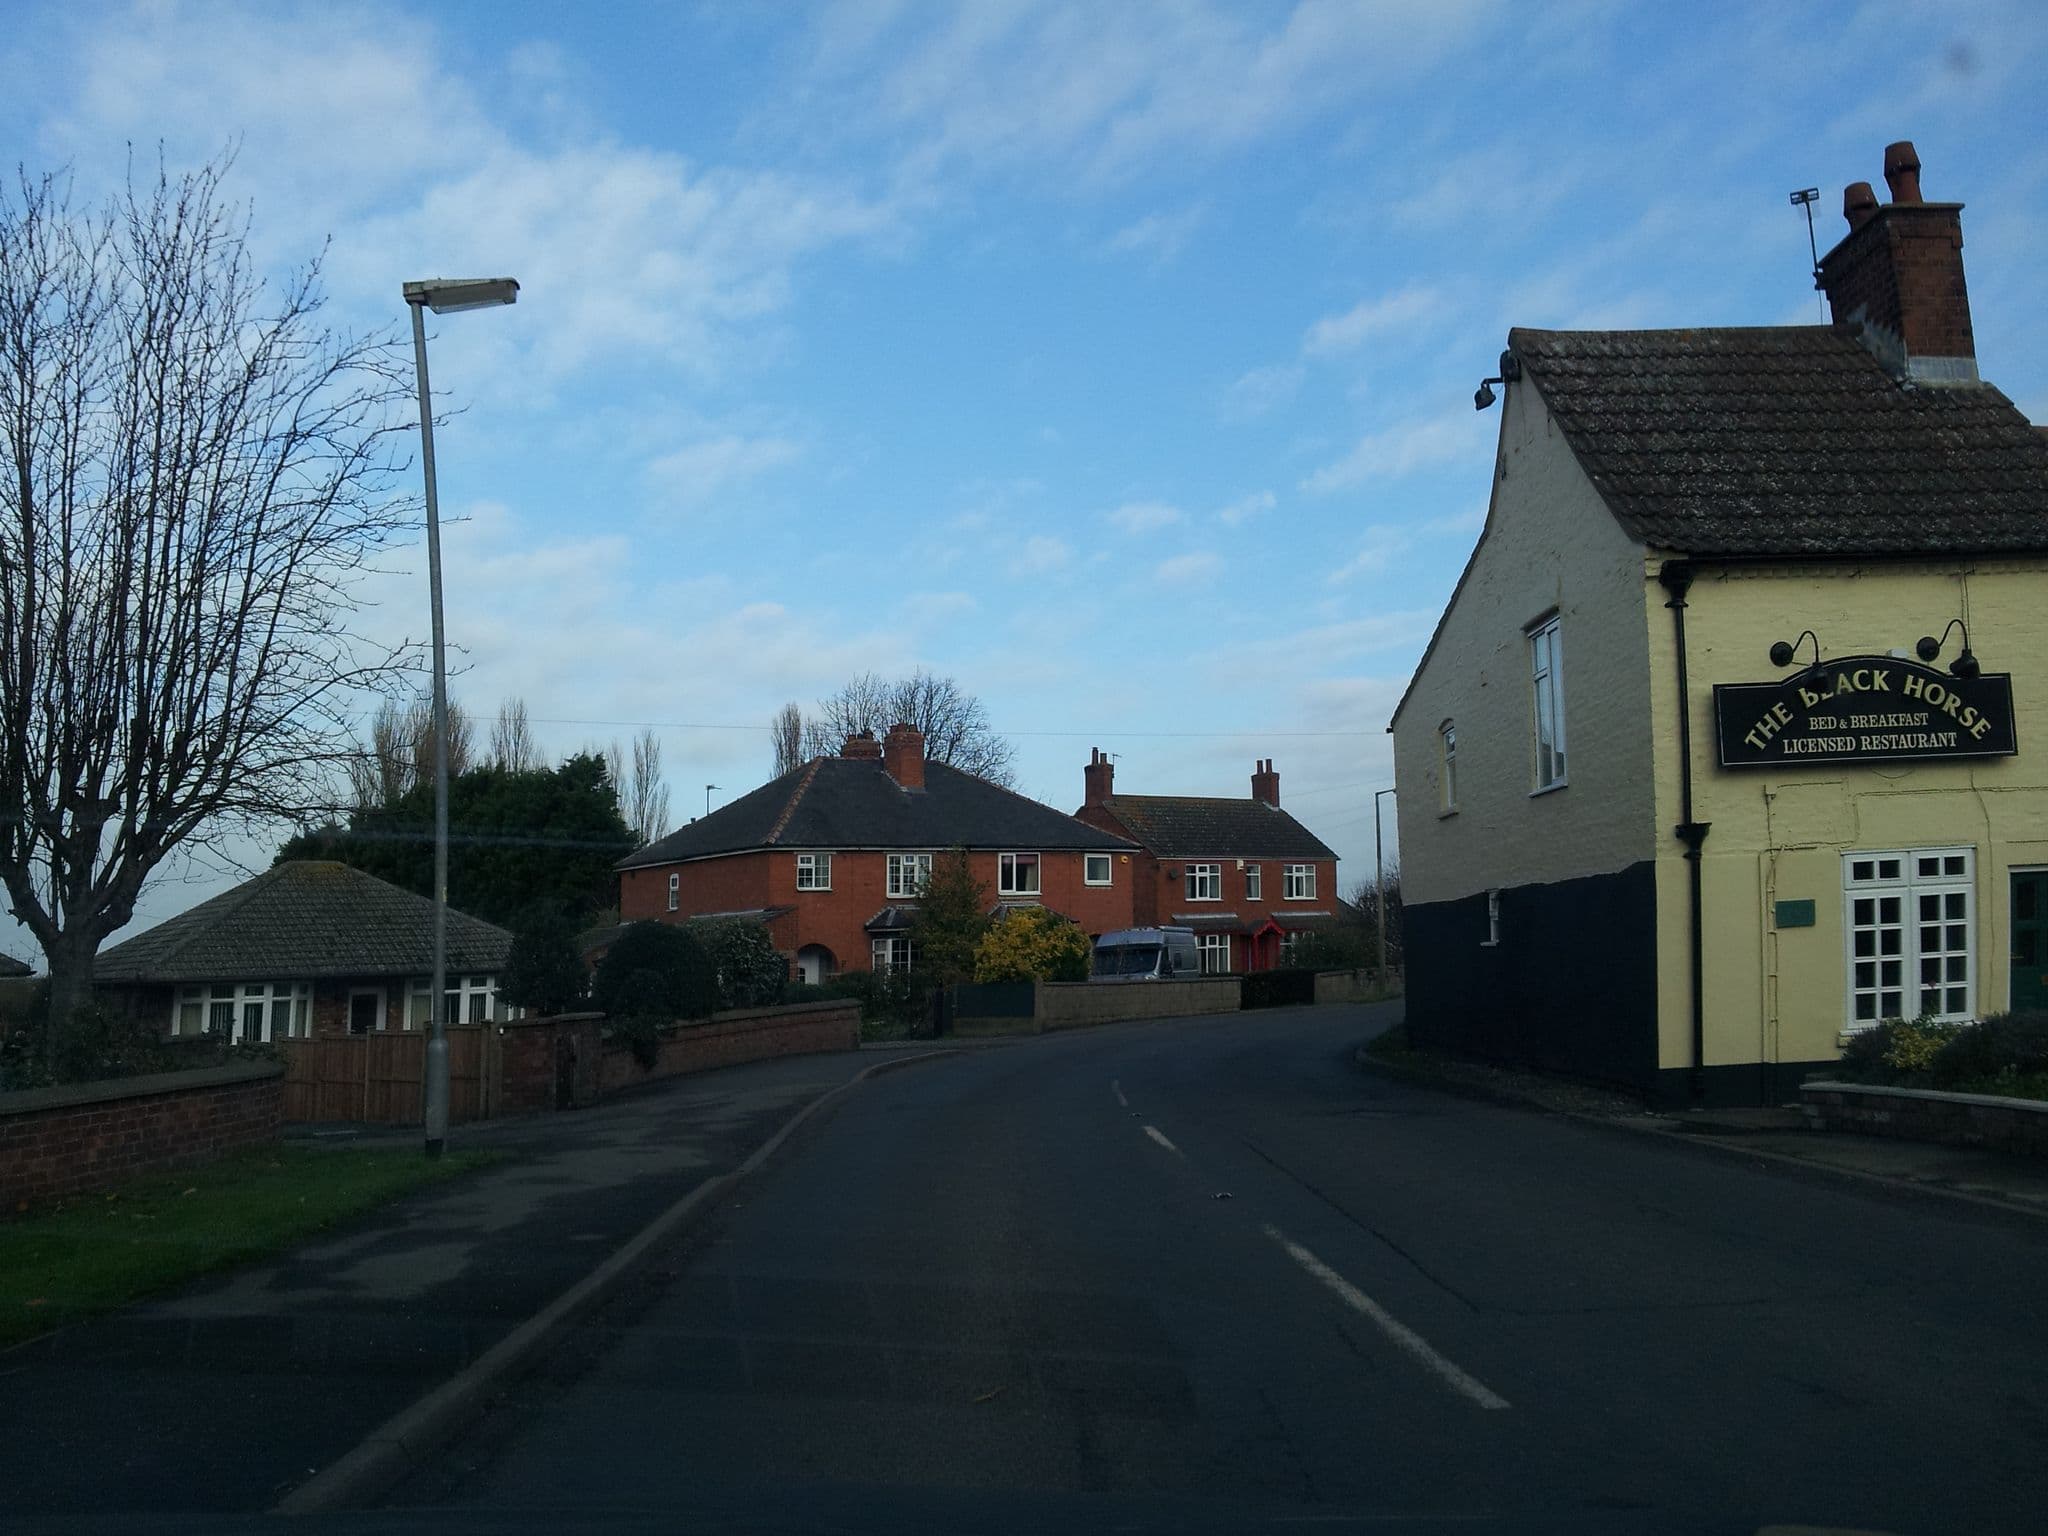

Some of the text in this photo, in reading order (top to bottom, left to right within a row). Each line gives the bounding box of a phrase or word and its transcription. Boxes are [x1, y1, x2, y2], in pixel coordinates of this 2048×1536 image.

[1744, 703, 1794, 751] THE
[1903, 674, 1991, 740] HORSE
[1809, 712, 1928, 730] BED & BREAKFAST
[1783, 732, 1957, 754] LICENSED RESTAURANT
